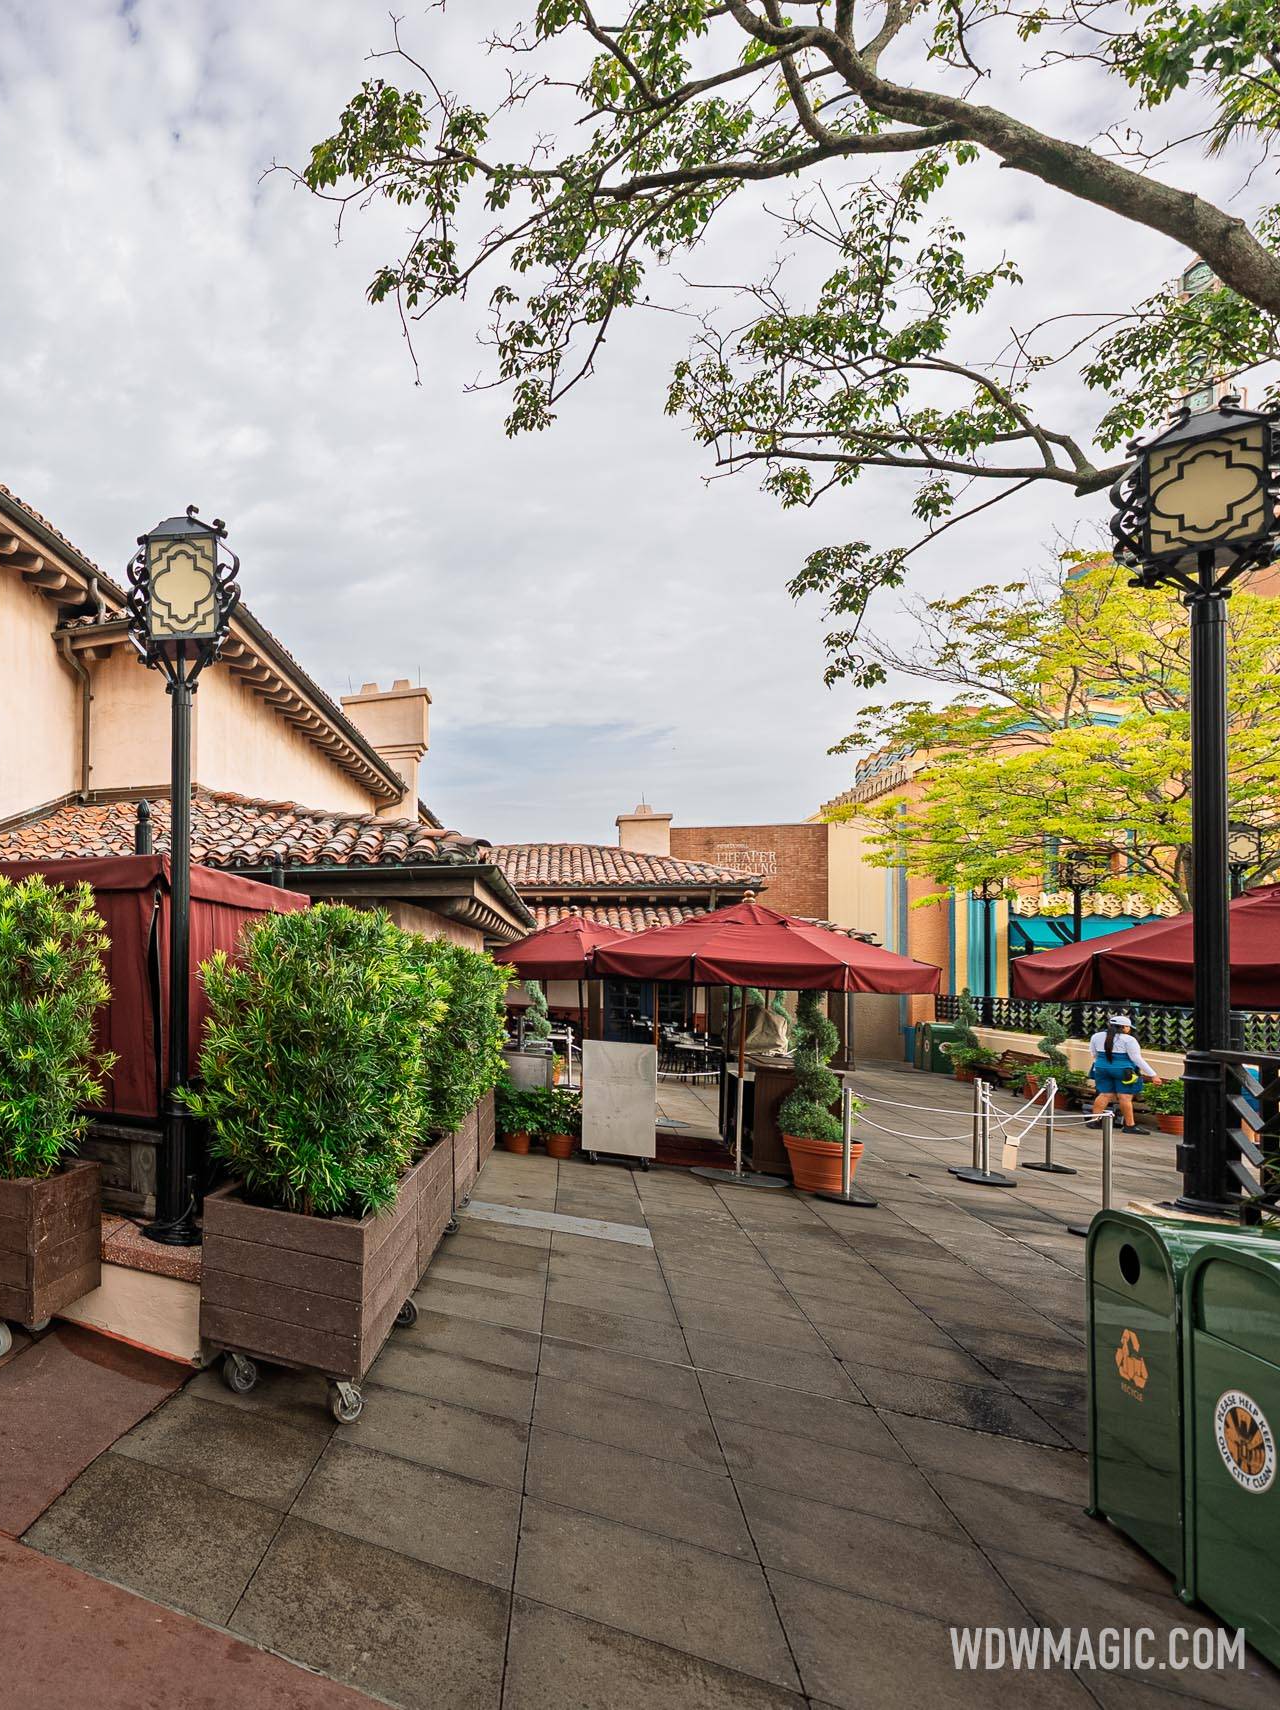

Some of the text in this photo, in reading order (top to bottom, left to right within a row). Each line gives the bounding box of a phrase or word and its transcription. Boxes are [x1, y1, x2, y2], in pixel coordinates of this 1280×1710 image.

[716, 851, 777, 863] THEATER
[1217, 1395, 1274, 1453] PLEASE HELP KEEP
[1219, 1436, 1273, 1489] OUR CITY CLEAN
